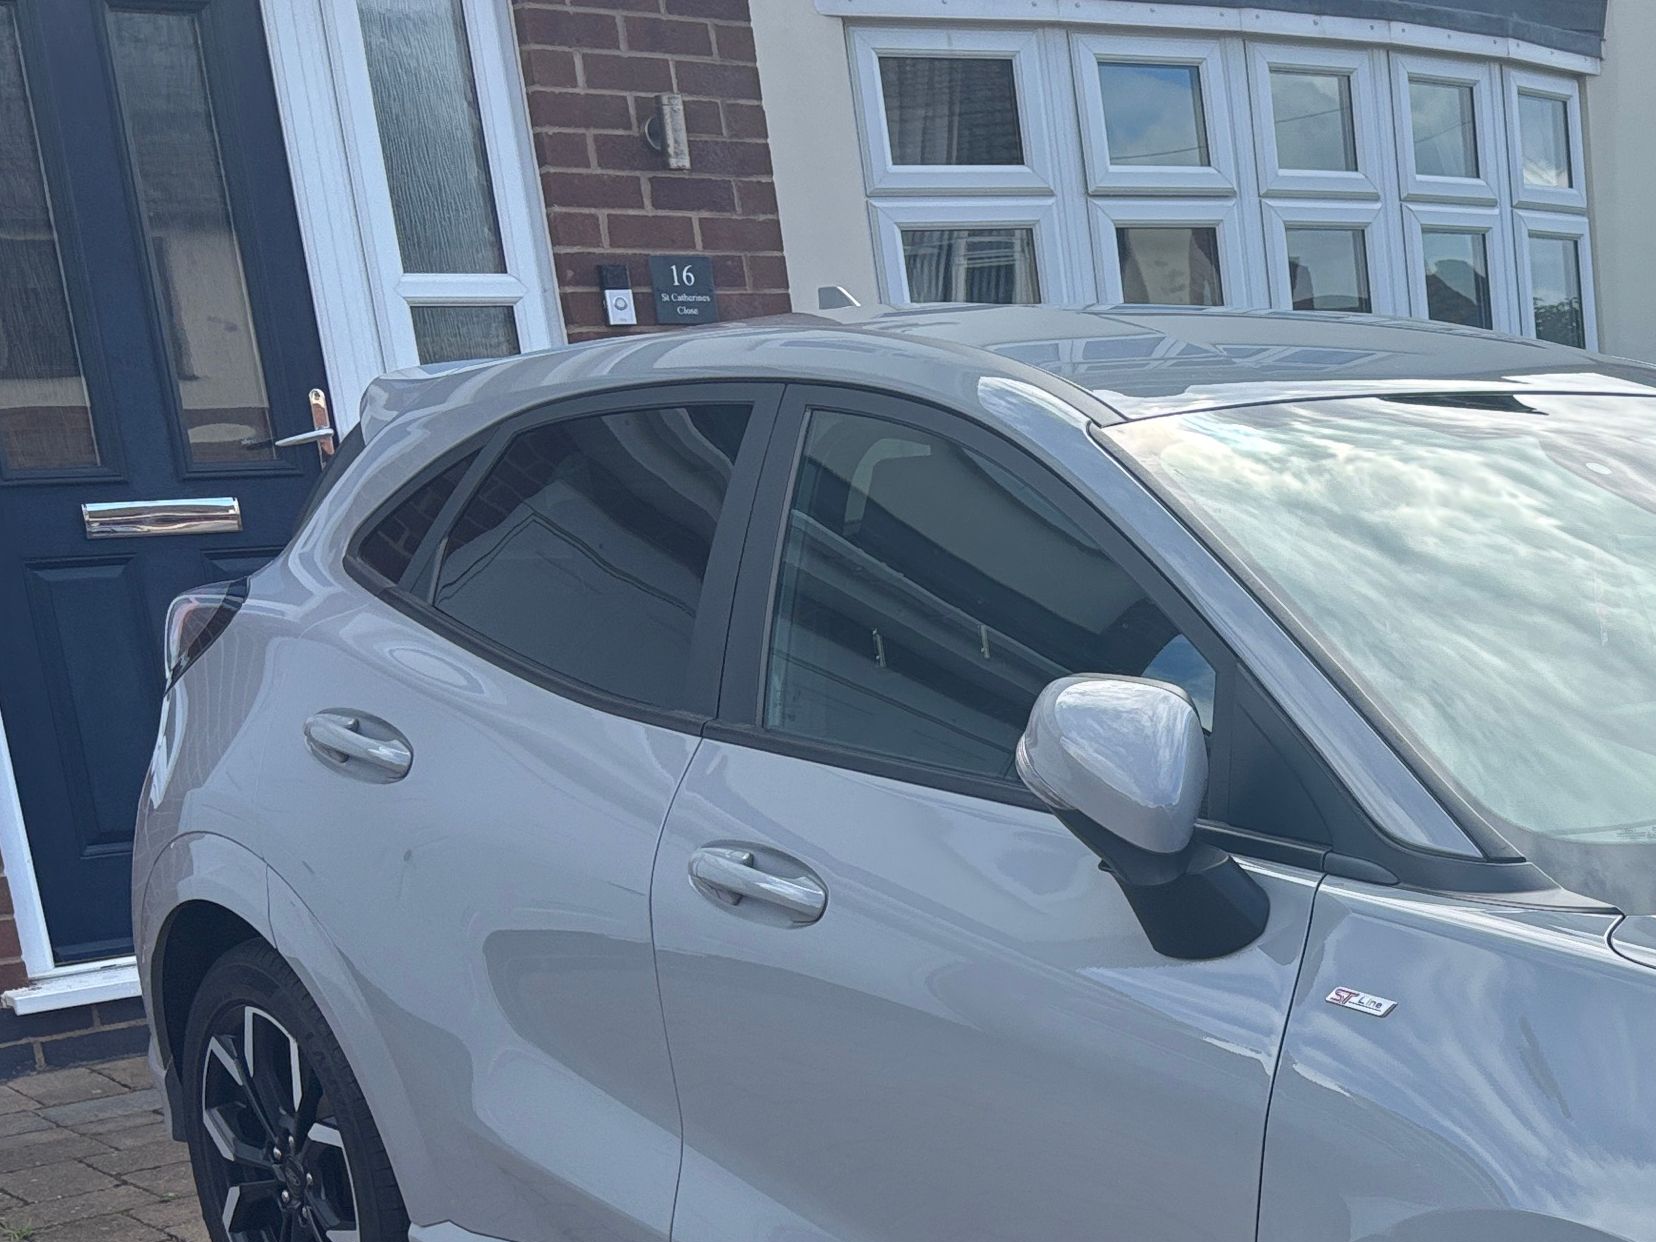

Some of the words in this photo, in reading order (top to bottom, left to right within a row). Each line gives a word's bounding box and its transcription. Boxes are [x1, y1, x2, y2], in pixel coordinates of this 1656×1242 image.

[671, 264, 695, 286] 16
[661, 293, 670, 302] St
[677, 305, 699, 315] Close
